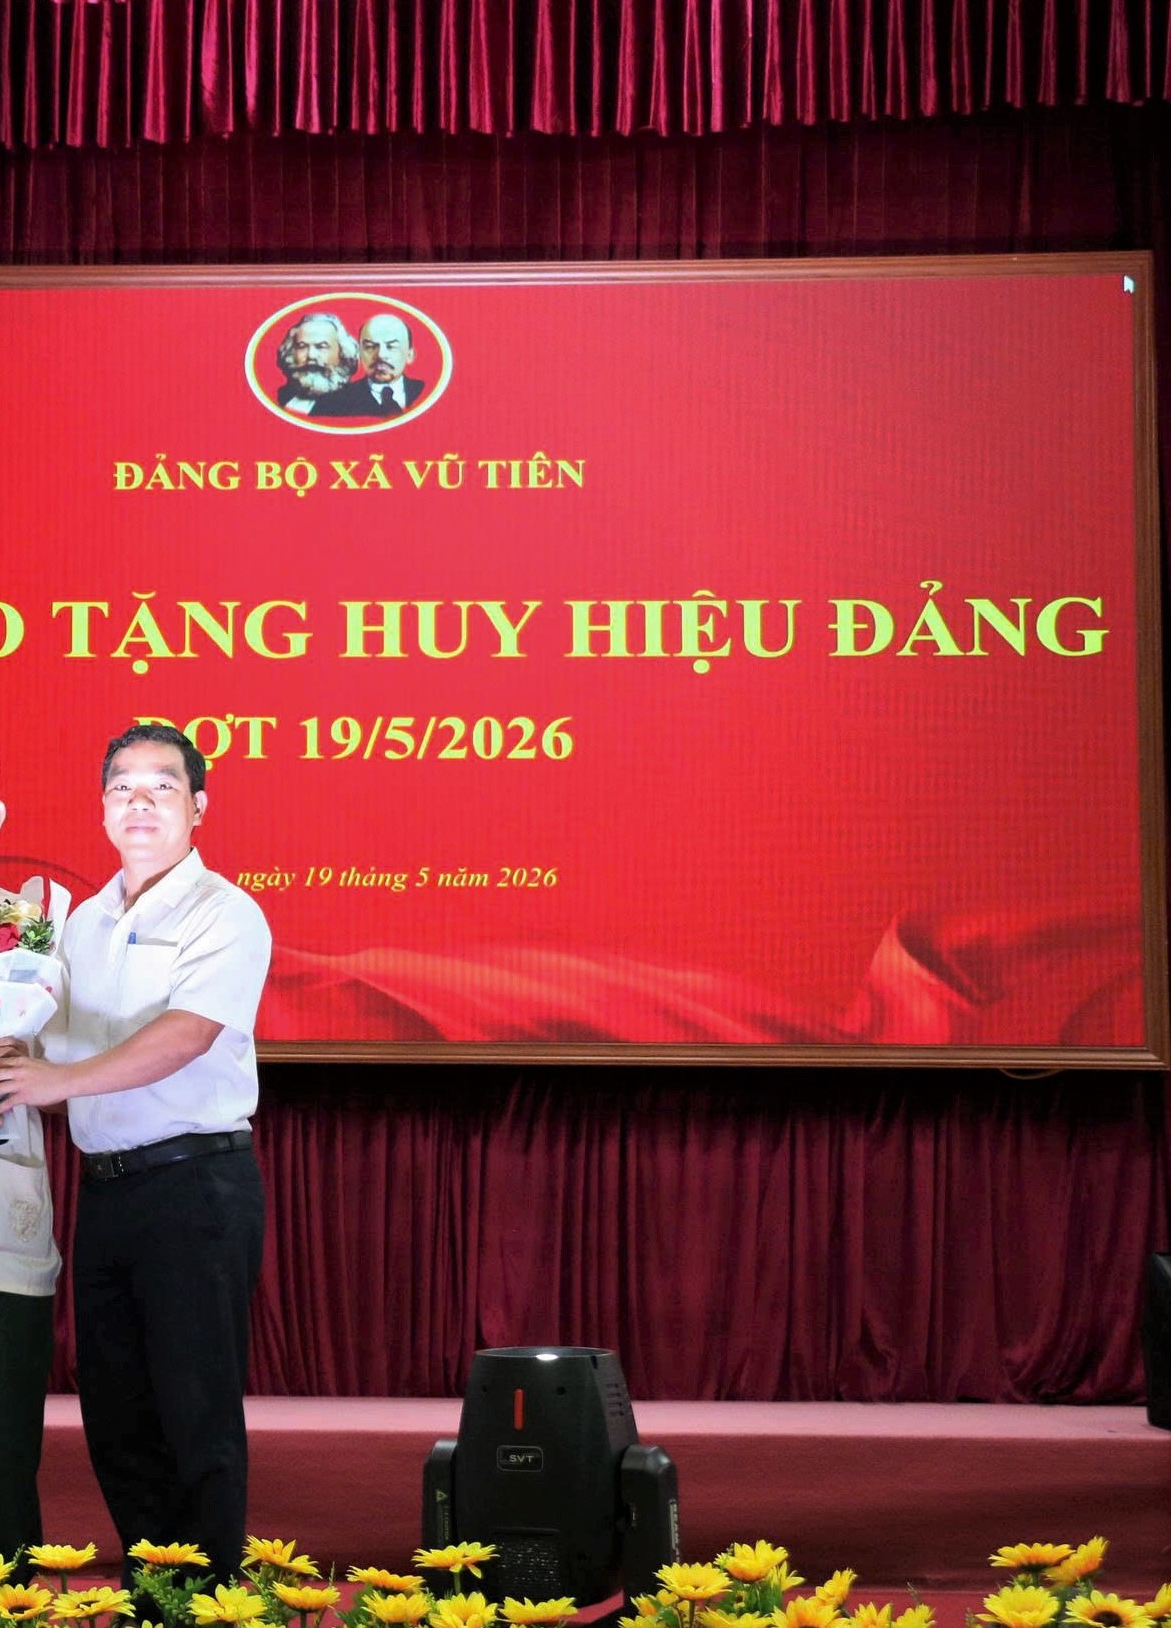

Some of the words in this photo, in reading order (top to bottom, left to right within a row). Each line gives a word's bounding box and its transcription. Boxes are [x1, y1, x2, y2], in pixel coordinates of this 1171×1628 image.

[113, 453, 241, 491] ĐẢNG
[255, 457, 318, 497] BỘ
[330, 453, 393, 490] XÃ
[404, 453, 466, 490] VŨ
[478, 451, 586, 489] TIÊN
[52, 592, 313, 675] TẶNG
[340, 600, 543, 659] HUY
[564, 589, 802, 675] HIỆU
[827, 580, 1110, 657] ĐẢNG
[133, 713, 277, 771] ỢT
[300, 716, 574, 761] 19/5/2026
[236, 866, 296, 891] ngày
[305, 867, 333, 888] 19
[339, 867, 408, 892] tháng
[416, 867, 430, 888] 5
[437, 867, 489, 888] năm
[496, 867, 558, 888] 2026
[509, 1454, 534, 1463] SVT
